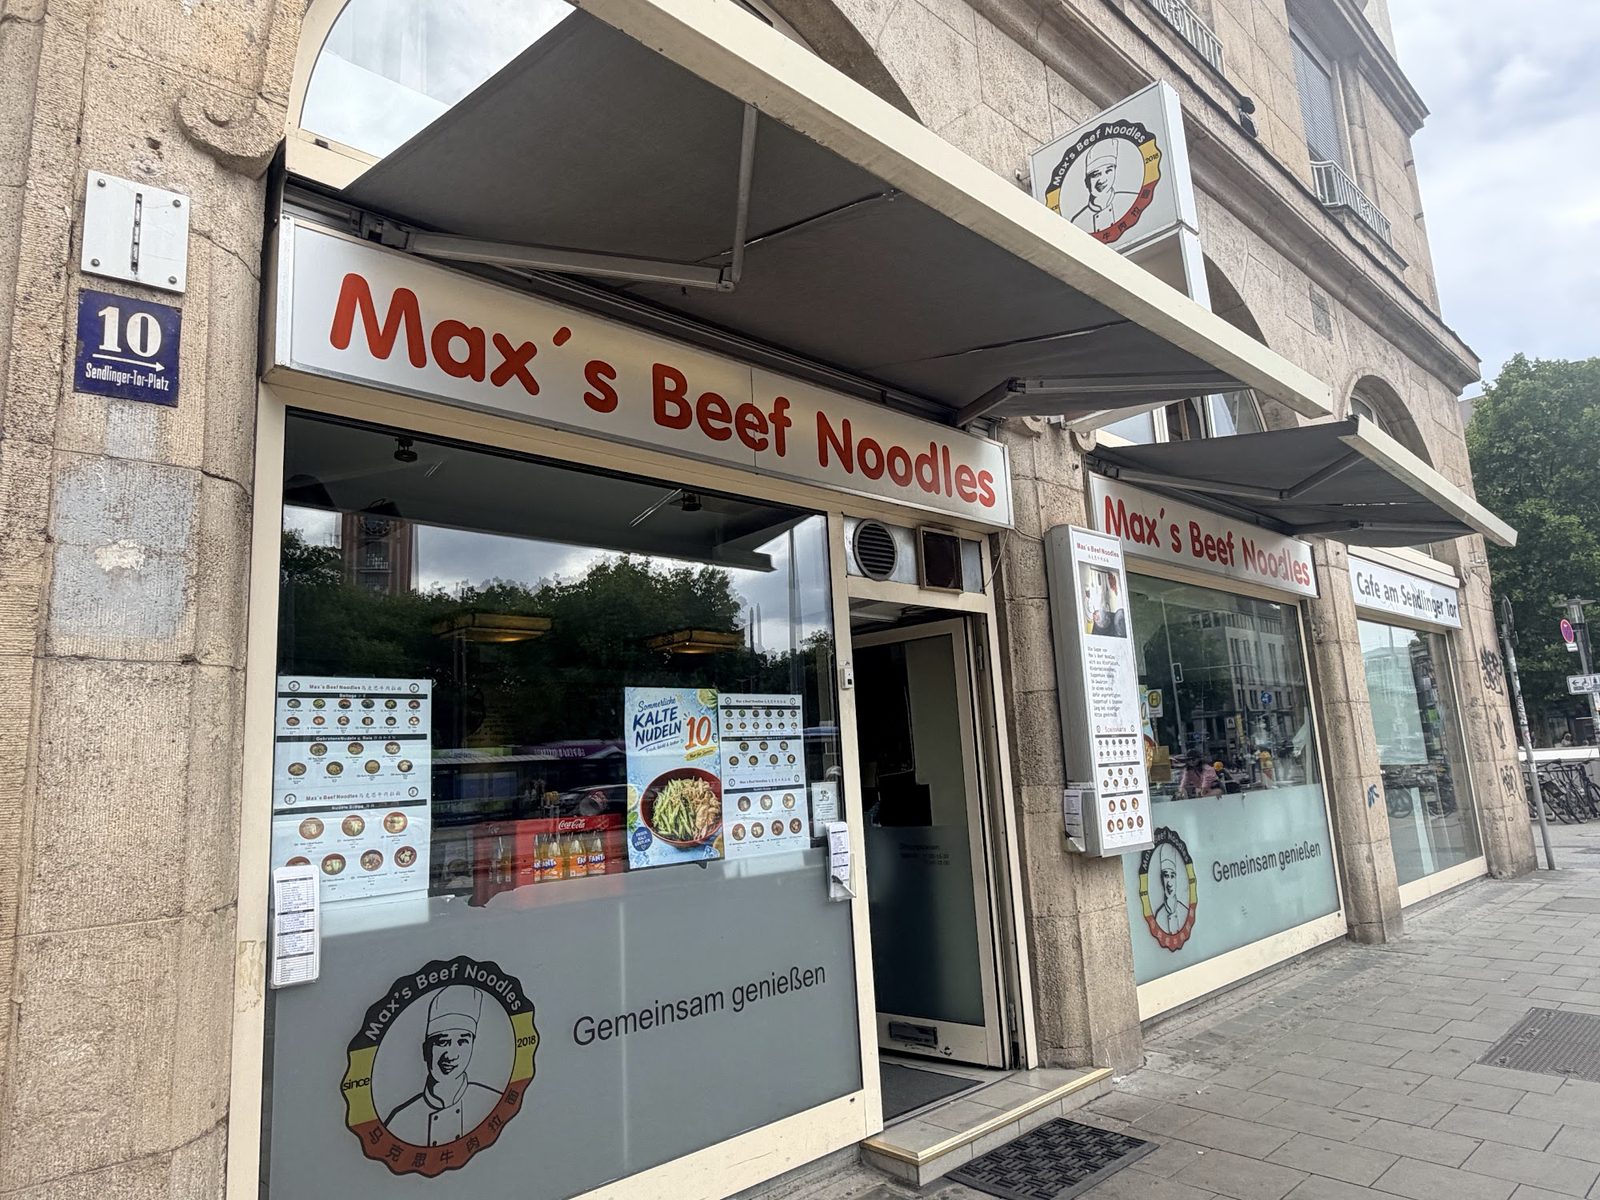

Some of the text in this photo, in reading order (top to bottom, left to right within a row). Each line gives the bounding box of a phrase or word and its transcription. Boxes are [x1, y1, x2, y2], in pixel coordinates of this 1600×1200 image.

[1076, 128, 1102, 152] Beef
[1104, 125, 1147, 144] Noodles
[97, 306, 163, 358] 10
[84, 362, 170, 391] Sendlinger-Tor-Platz
[652, 363, 792, 457] Beef
[816, 410, 996, 508] Noodles
[1189, 520, 1235, 567] Beef
[1242, 537, 1311, 587] Noodles
[1383, 584, 1399, 604] am
[1400, 584, 1444, 619] Sendlinger
[1445, 598, 1457, 617] Tor
[632, 706, 679, 732] KALTE
[635, 720, 682, 748] NUDELN
[684, 715, 711, 750] 10
[1212, 841, 1322, 883] Gemeinsam genießen
[415, 963, 459, 989] Beef
[464, 964, 521, 1012] Noodles
[573, 966, 826, 1046] Gemeinsam genießen
[517, 1035, 537, 1048] 2018
[343, 1076, 371, 1091] since
